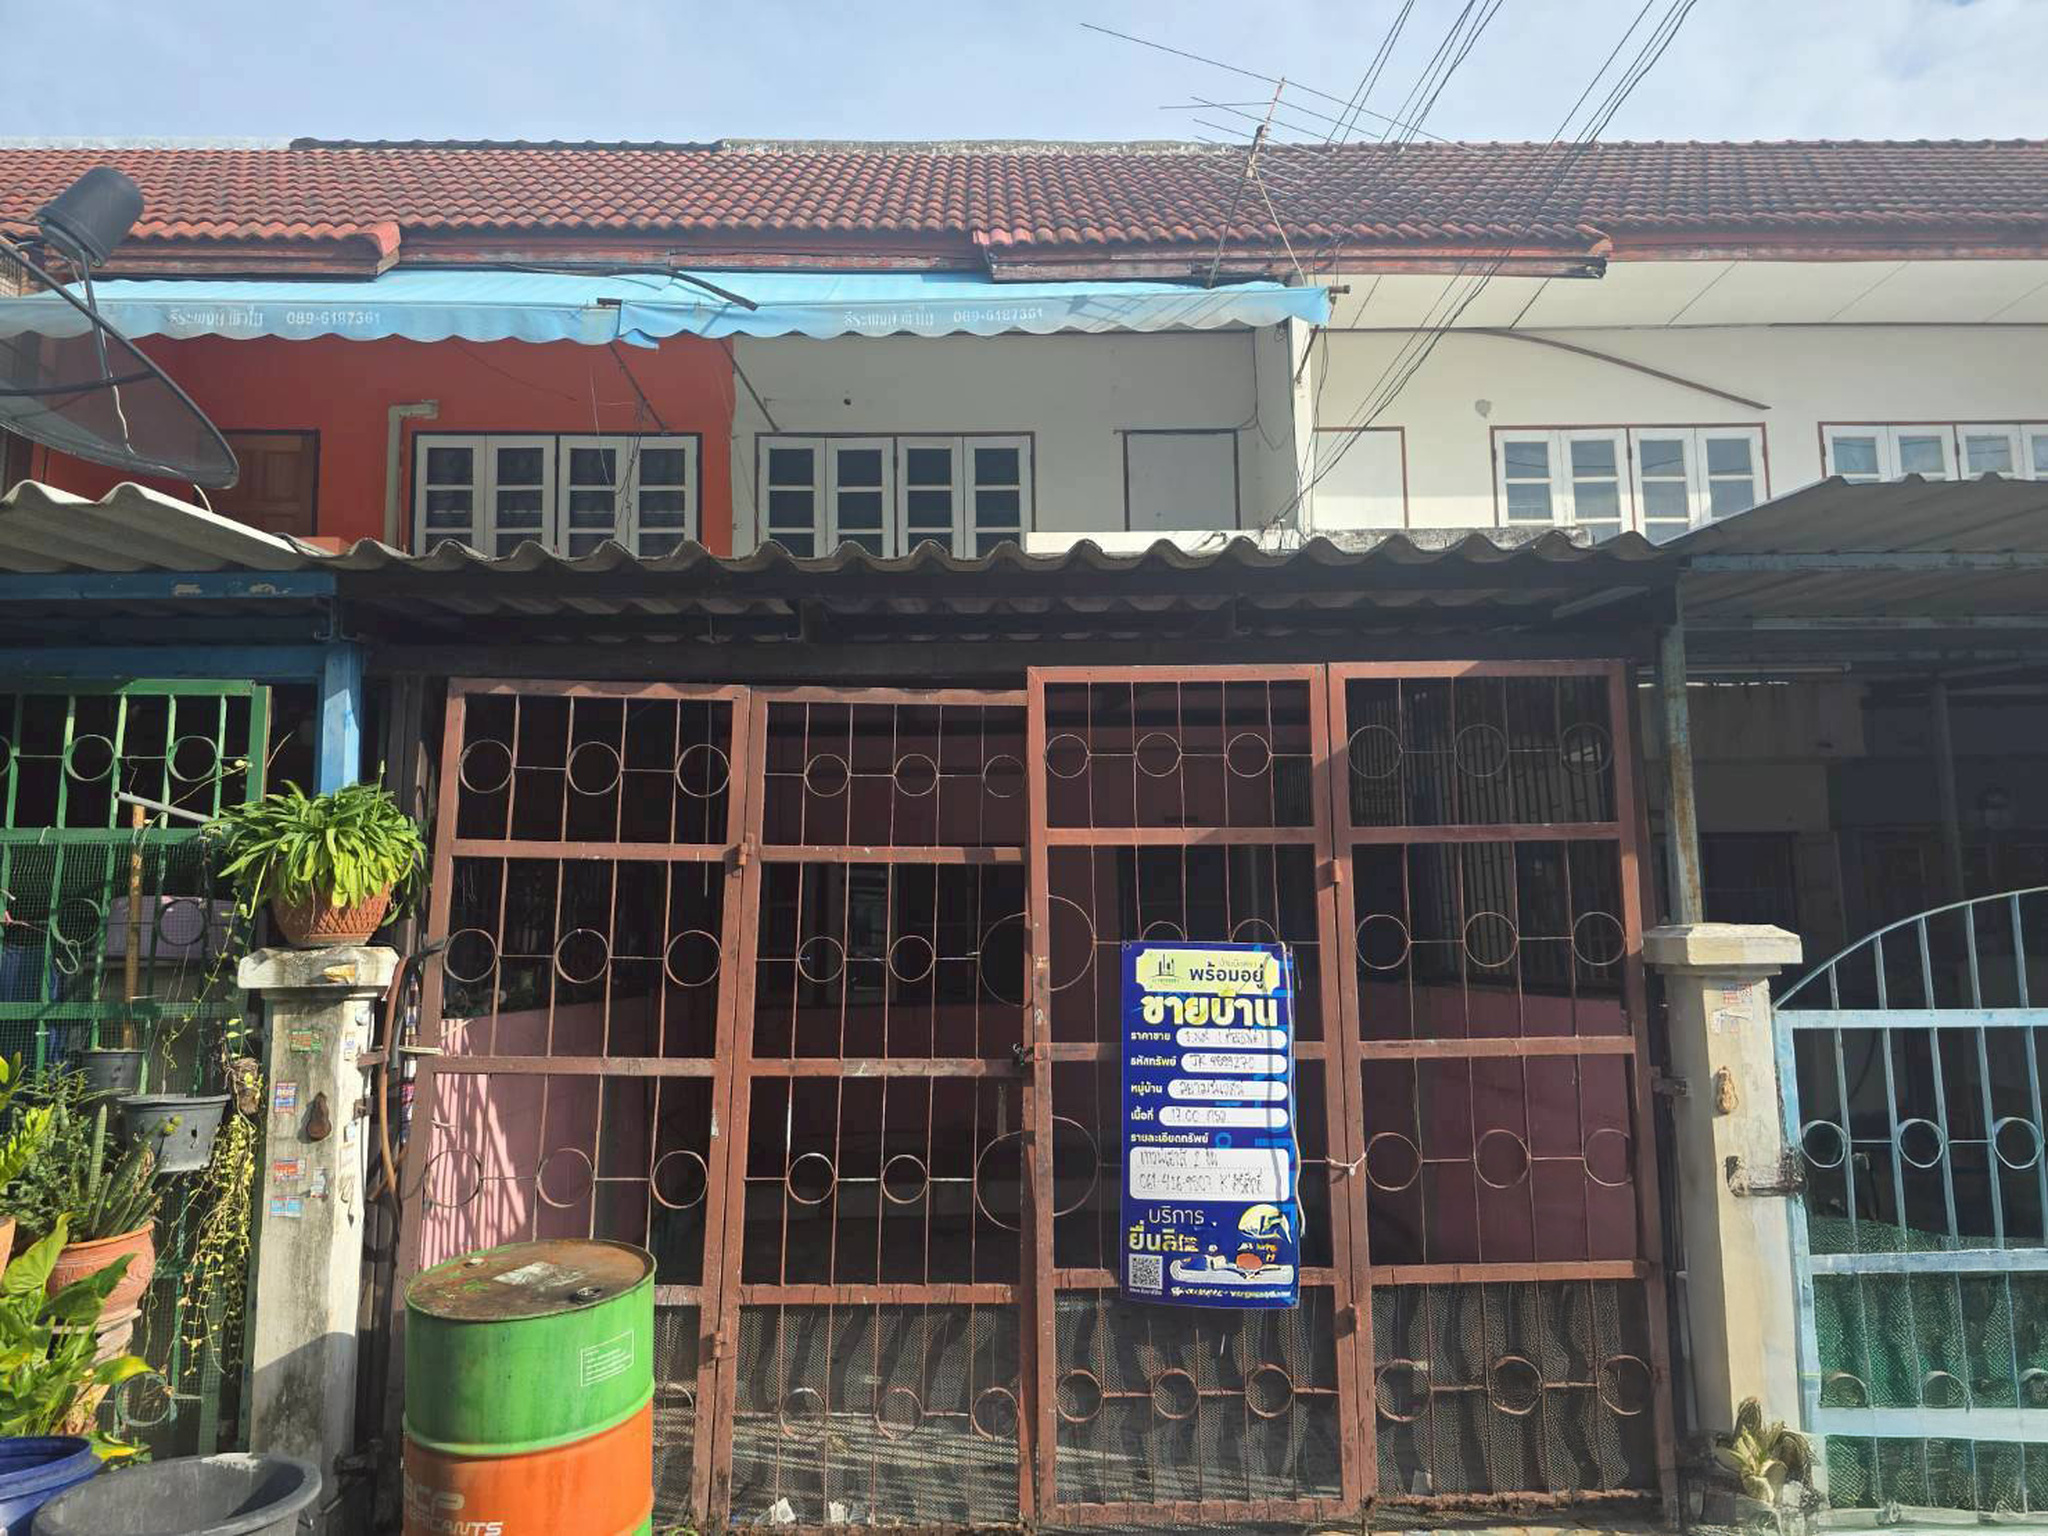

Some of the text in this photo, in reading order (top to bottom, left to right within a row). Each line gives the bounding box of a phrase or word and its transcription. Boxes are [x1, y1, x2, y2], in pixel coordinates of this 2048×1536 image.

[1189, 960, 1265, 990] พร้อมอยู่
[1141, 987, 1279, 1027] ขายบ้าน
[1130, 1031, 1171, 1041] ราคาขาย
[1130, 1054, 1177, 1067] รหัสทรัพย์
[1130, 1081, 1163, 1097] หมู่บ้าน
[1130, 1105, 1155, 1121] เนื้อที่
[1130, 1132, 1210, 1144] รายละเอียดทรัพย์
[1148, 1205, 1205, 1225] บริการ
